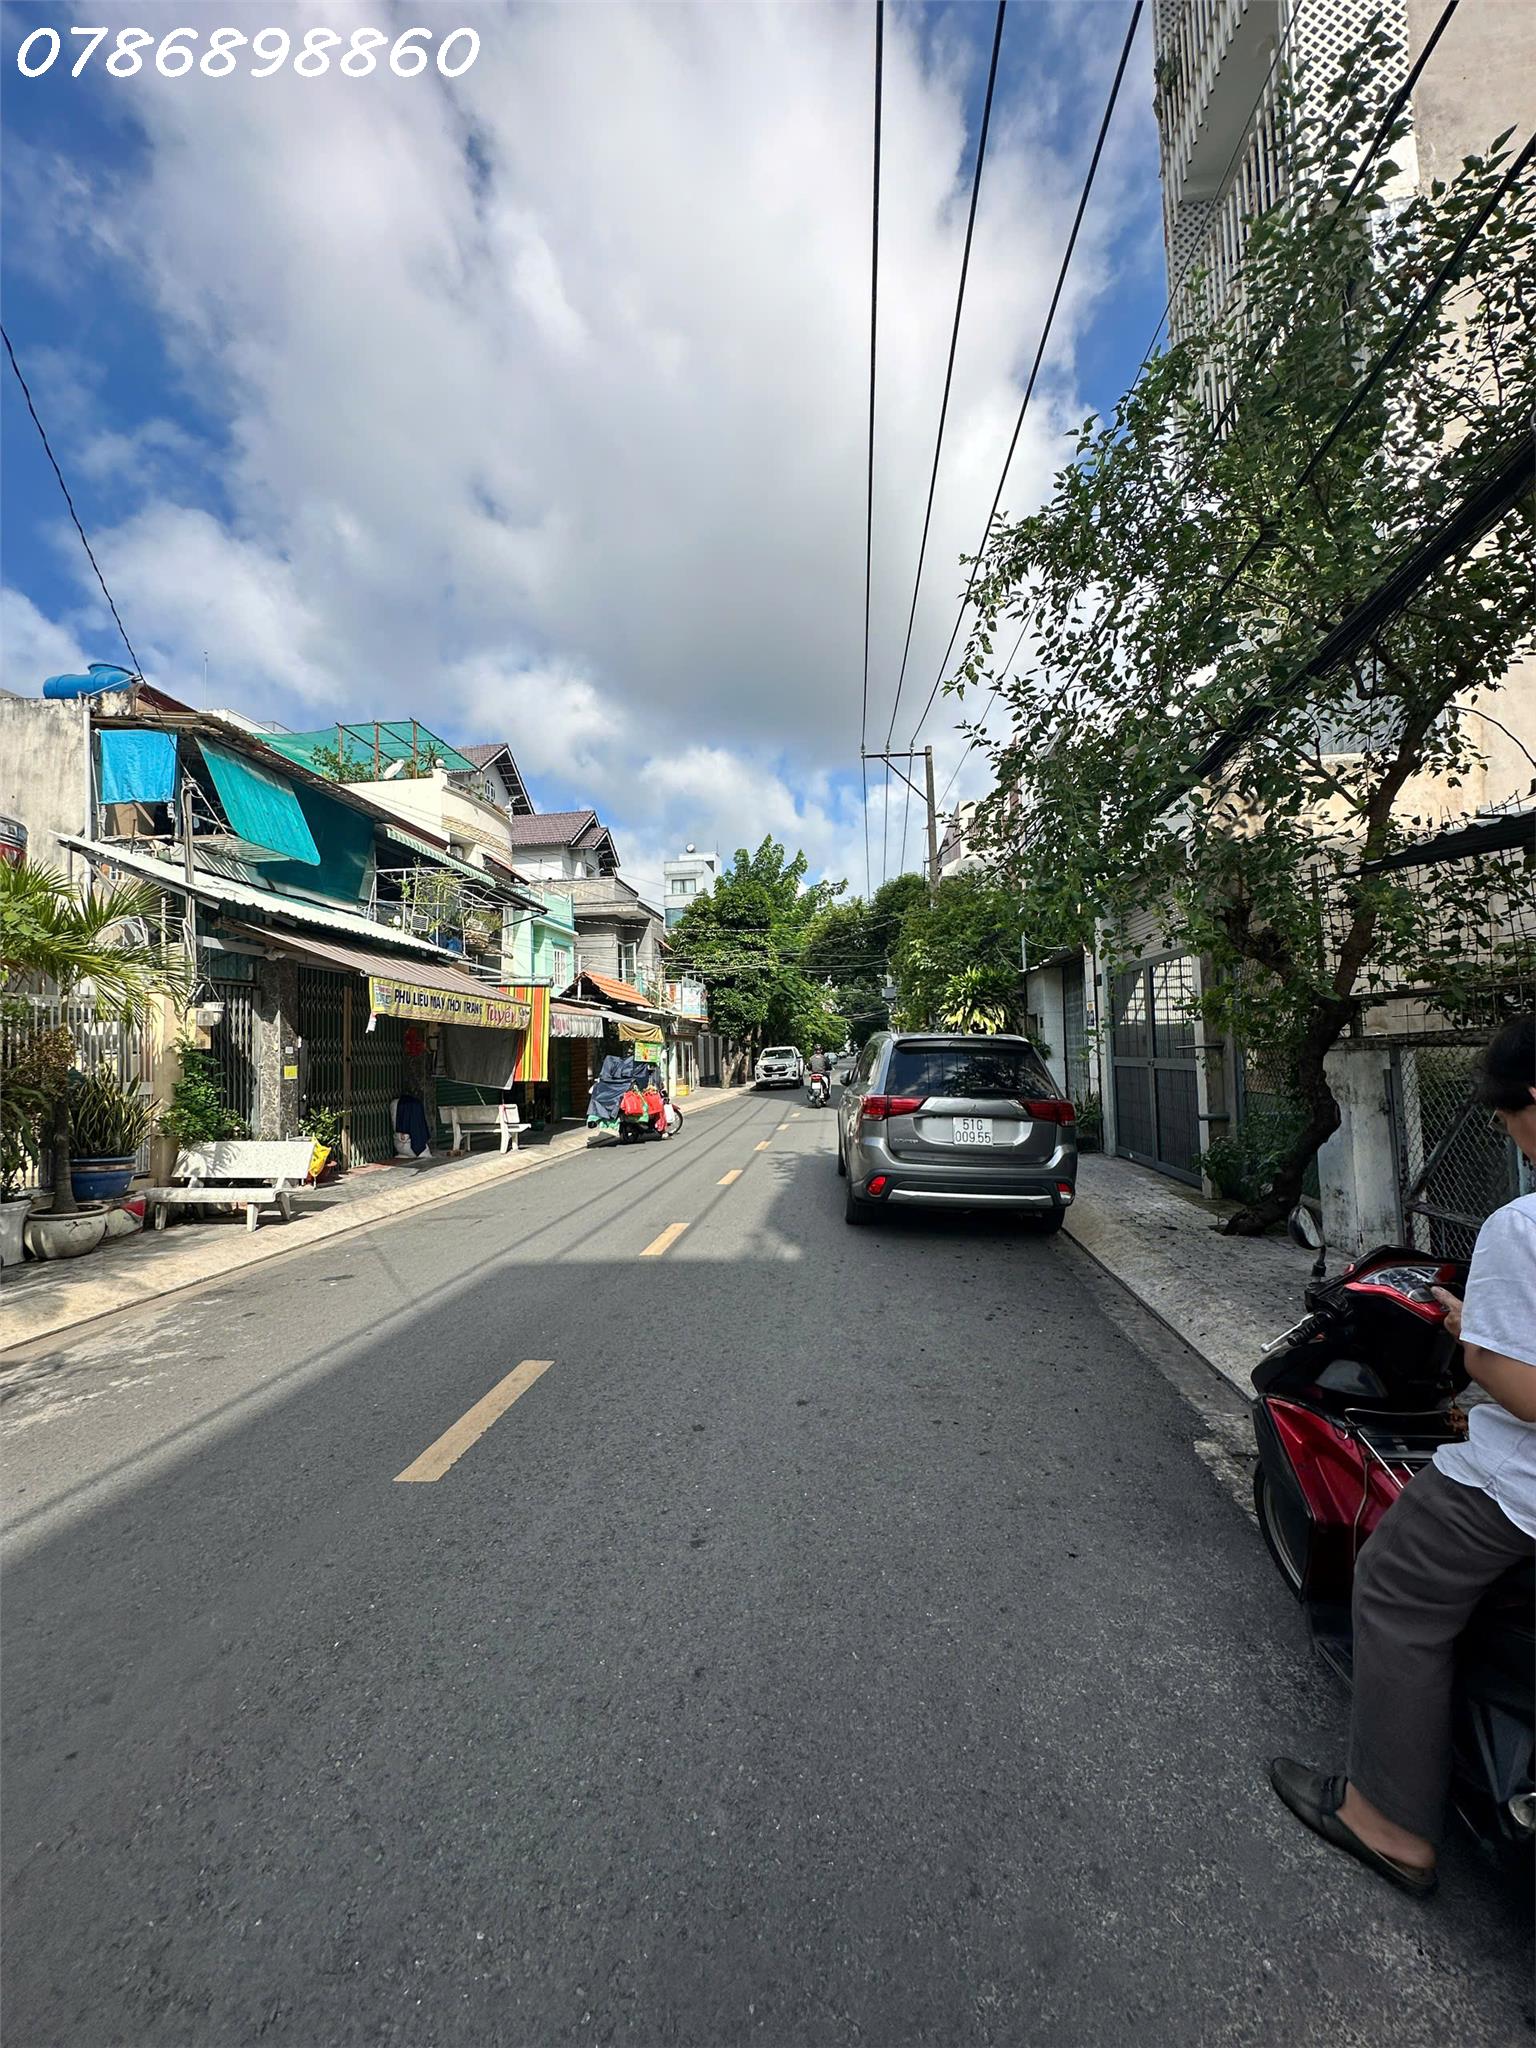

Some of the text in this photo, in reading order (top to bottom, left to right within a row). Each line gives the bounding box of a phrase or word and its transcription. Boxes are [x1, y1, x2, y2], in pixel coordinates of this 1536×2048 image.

[430, 995, 445, 1010] MAY
[962, 1118, 983, 1131] 51G
[955, 1131, 991, 1144] 009.55
